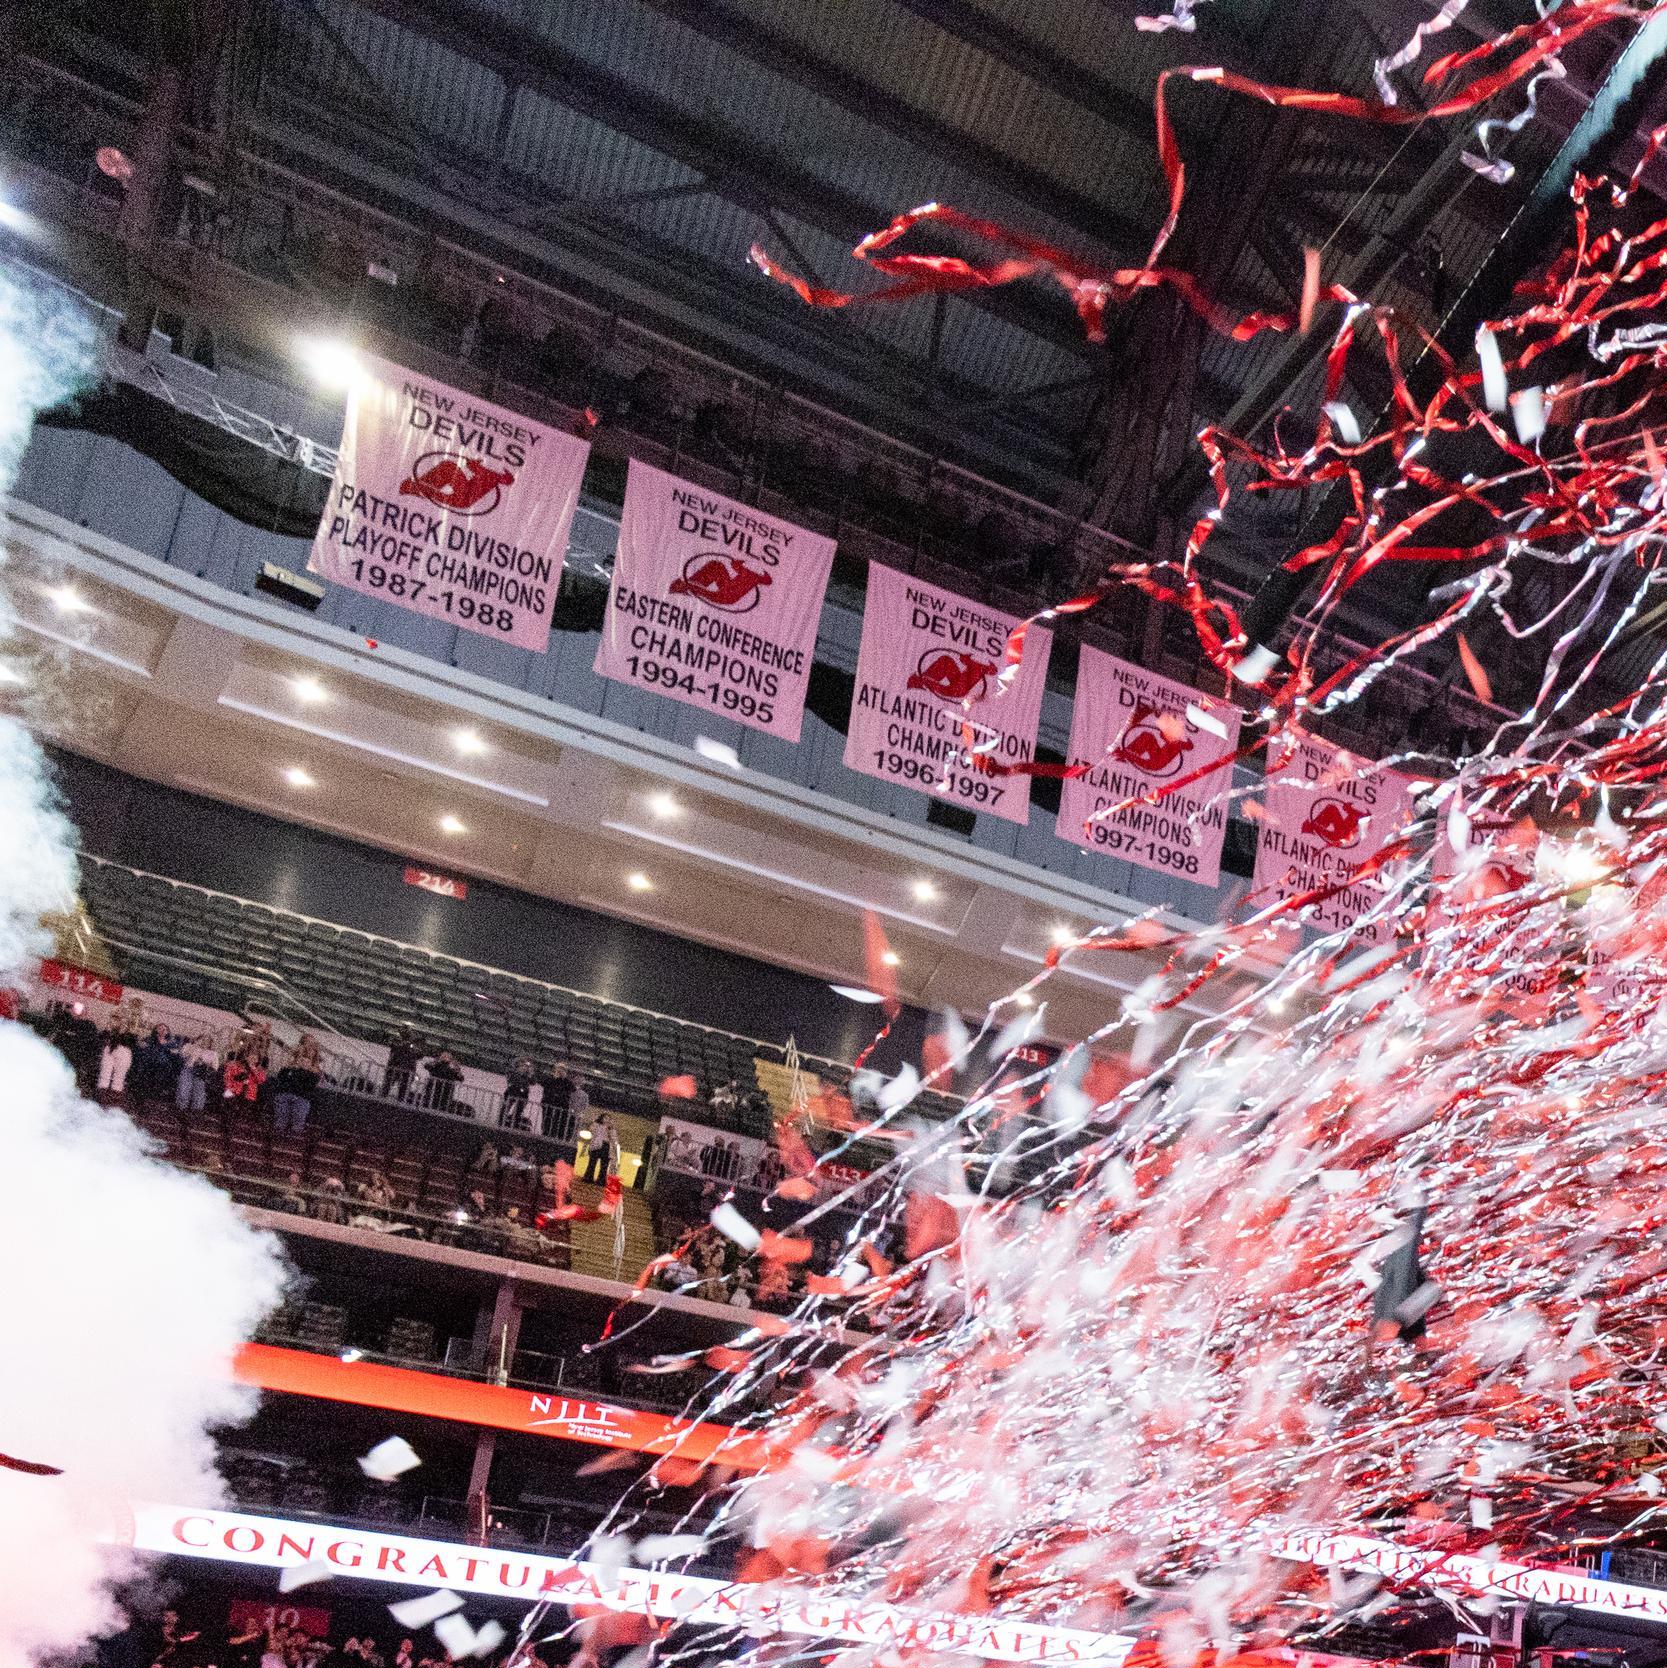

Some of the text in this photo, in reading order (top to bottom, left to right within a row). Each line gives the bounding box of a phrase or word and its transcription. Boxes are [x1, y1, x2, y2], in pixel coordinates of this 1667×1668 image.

[402, 383, 542, 448] NEW JERSEY
[408, 410, 527, 468] DEVILS
[339, 484, 553, 584] PATRICK DIVISION
[673, 488, 795, 547] NEW JERSEY
[679, 511, 781, 567] DEVILS
[328, 518, 547, 615] PLAYOFF CHAMPIONS
[350, 558, 514, 634] 1987-1988
[906, 587, 1013, 637] NEW JERSEY
[614, 586, 805, 676] EASTERN CONFERENCE
[912, 608, 1002, 657] DEVILS
[625, 655, 774, 724] 1994-1995
[630, 626, 779, 699] CHAMPIONS
[1113, 668, 1200, 708] NEW JERS
[857, 683, 946, 731] ATLANTIC
[873, 750, 1005, 806] 1996-1997
[1300, 743, 1332, 766] NEW
[1305, 761, 1377, 805] DVILS
[1088, 823, 1199, 875] 997-1998
[419, 872, 457, 894] 214
[530, 1395, 614, 1422] NJIT
